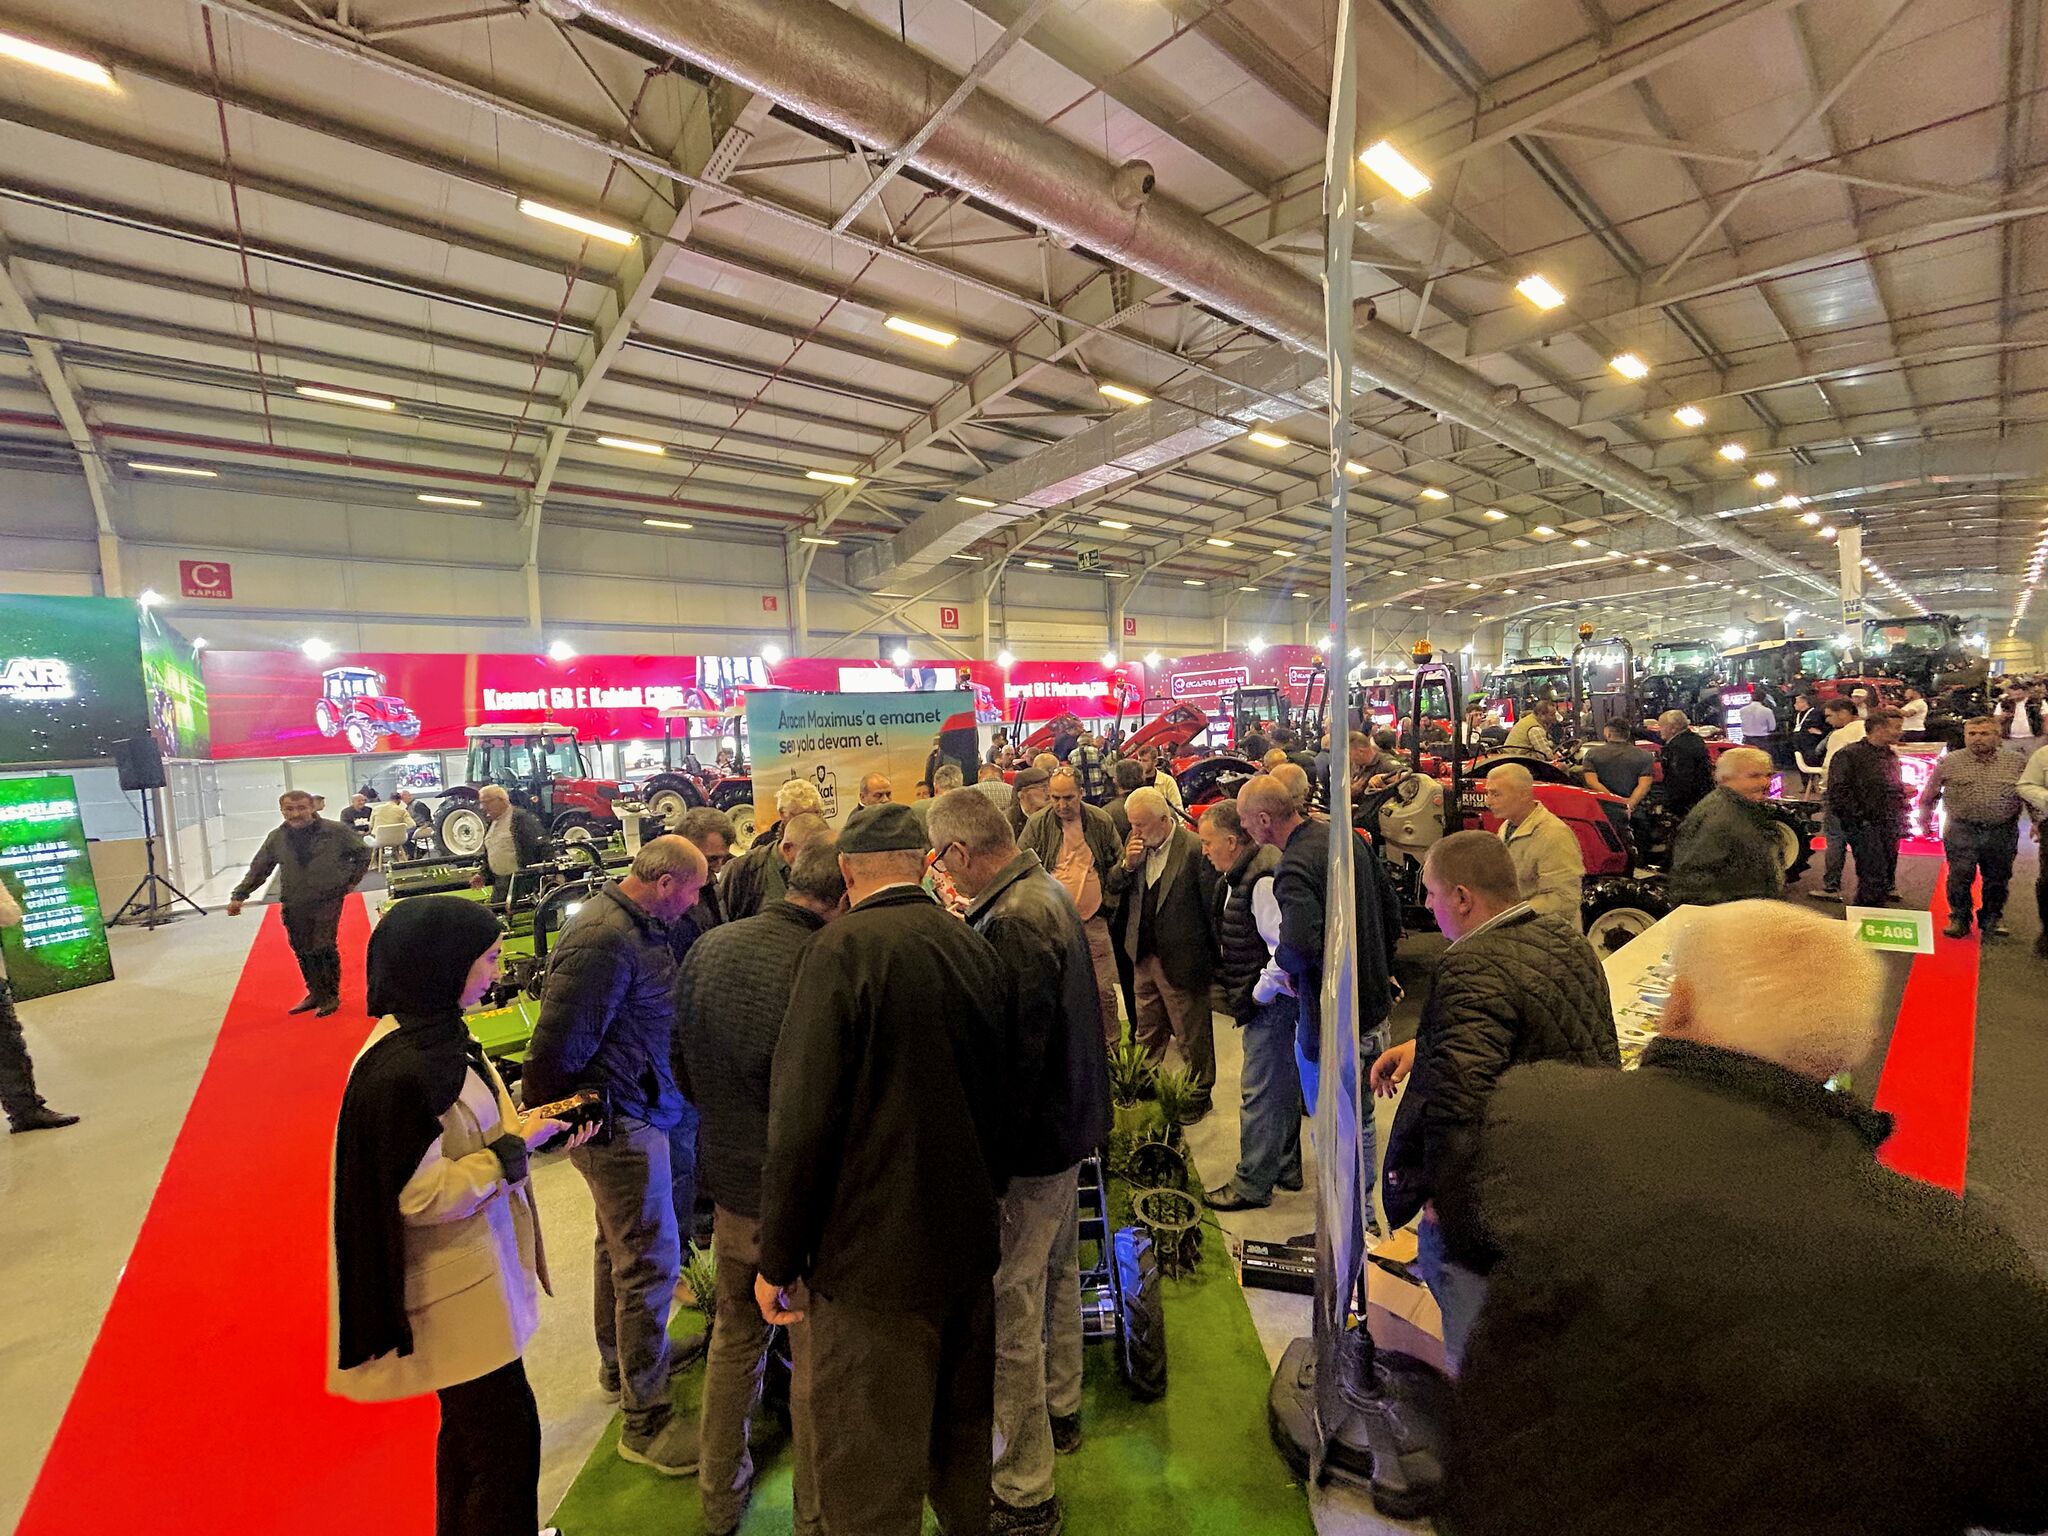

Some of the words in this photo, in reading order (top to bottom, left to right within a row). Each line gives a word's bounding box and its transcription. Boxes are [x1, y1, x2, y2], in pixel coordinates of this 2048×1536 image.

[191, 563, 220, 588] C
[188, 589, 227, 597] KAPISI
[945, 609, 954, 623] D
[1126, 619, 1134, 631] D
[576, 687, 589, 708] E
[807, 709, 876, 728] Maximus'a
[880, 709, 941, 725] emanet
[779, 740, 796, 754] sen
[797, 734, 815, 757] yola
[818, 733, 861, 750] devam
[865, 732, 883, 746] et.
